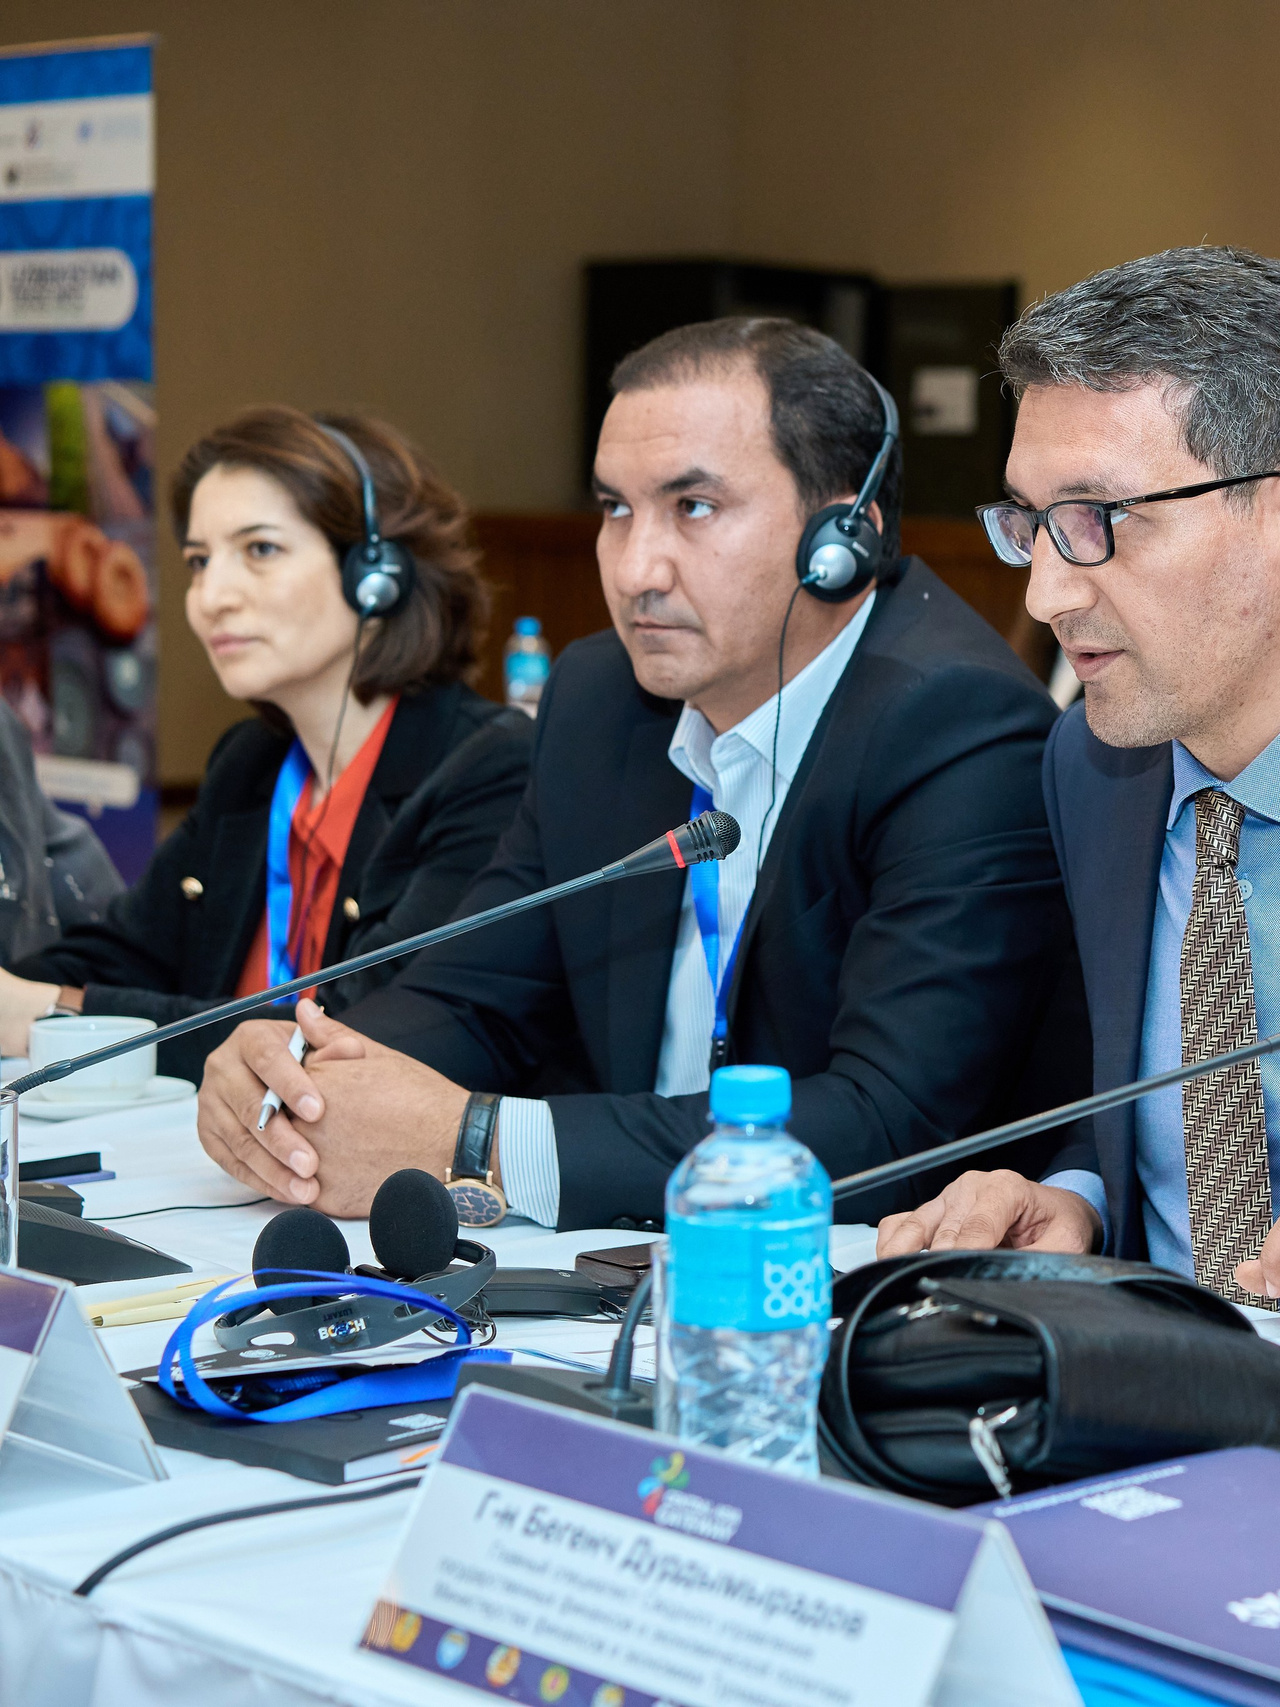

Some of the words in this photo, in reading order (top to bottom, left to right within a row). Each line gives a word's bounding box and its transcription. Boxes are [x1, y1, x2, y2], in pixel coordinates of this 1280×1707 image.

[318, 1318, 366, 1340] BOCH
[474, 1490, 521, 1528] Г-н
[522, 1503, 622, 1559] Бегенч
